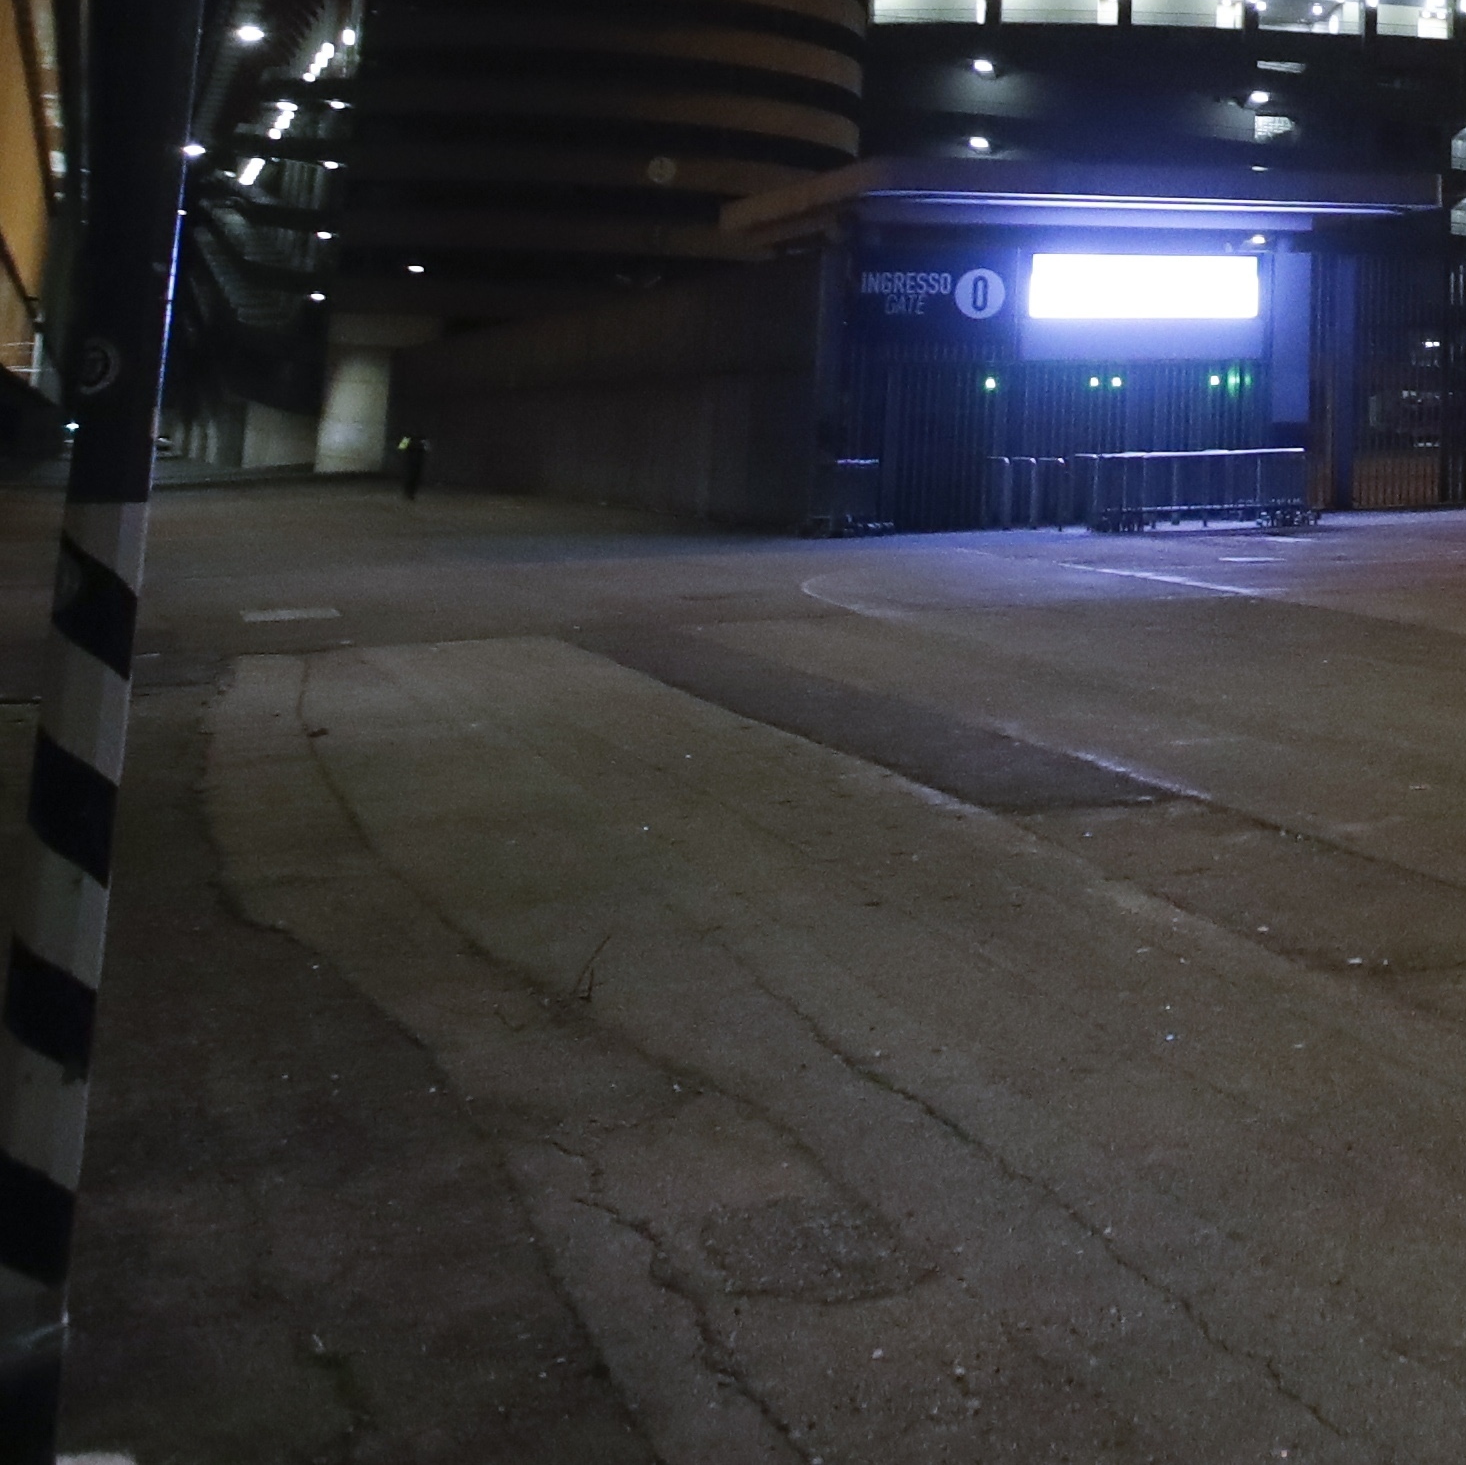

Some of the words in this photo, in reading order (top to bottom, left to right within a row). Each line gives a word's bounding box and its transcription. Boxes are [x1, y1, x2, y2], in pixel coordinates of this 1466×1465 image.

[861, 271, 951, 295] INGRESSO
[973, 275, 988, 311] 0
[885, 294, 925, 315] GATE
